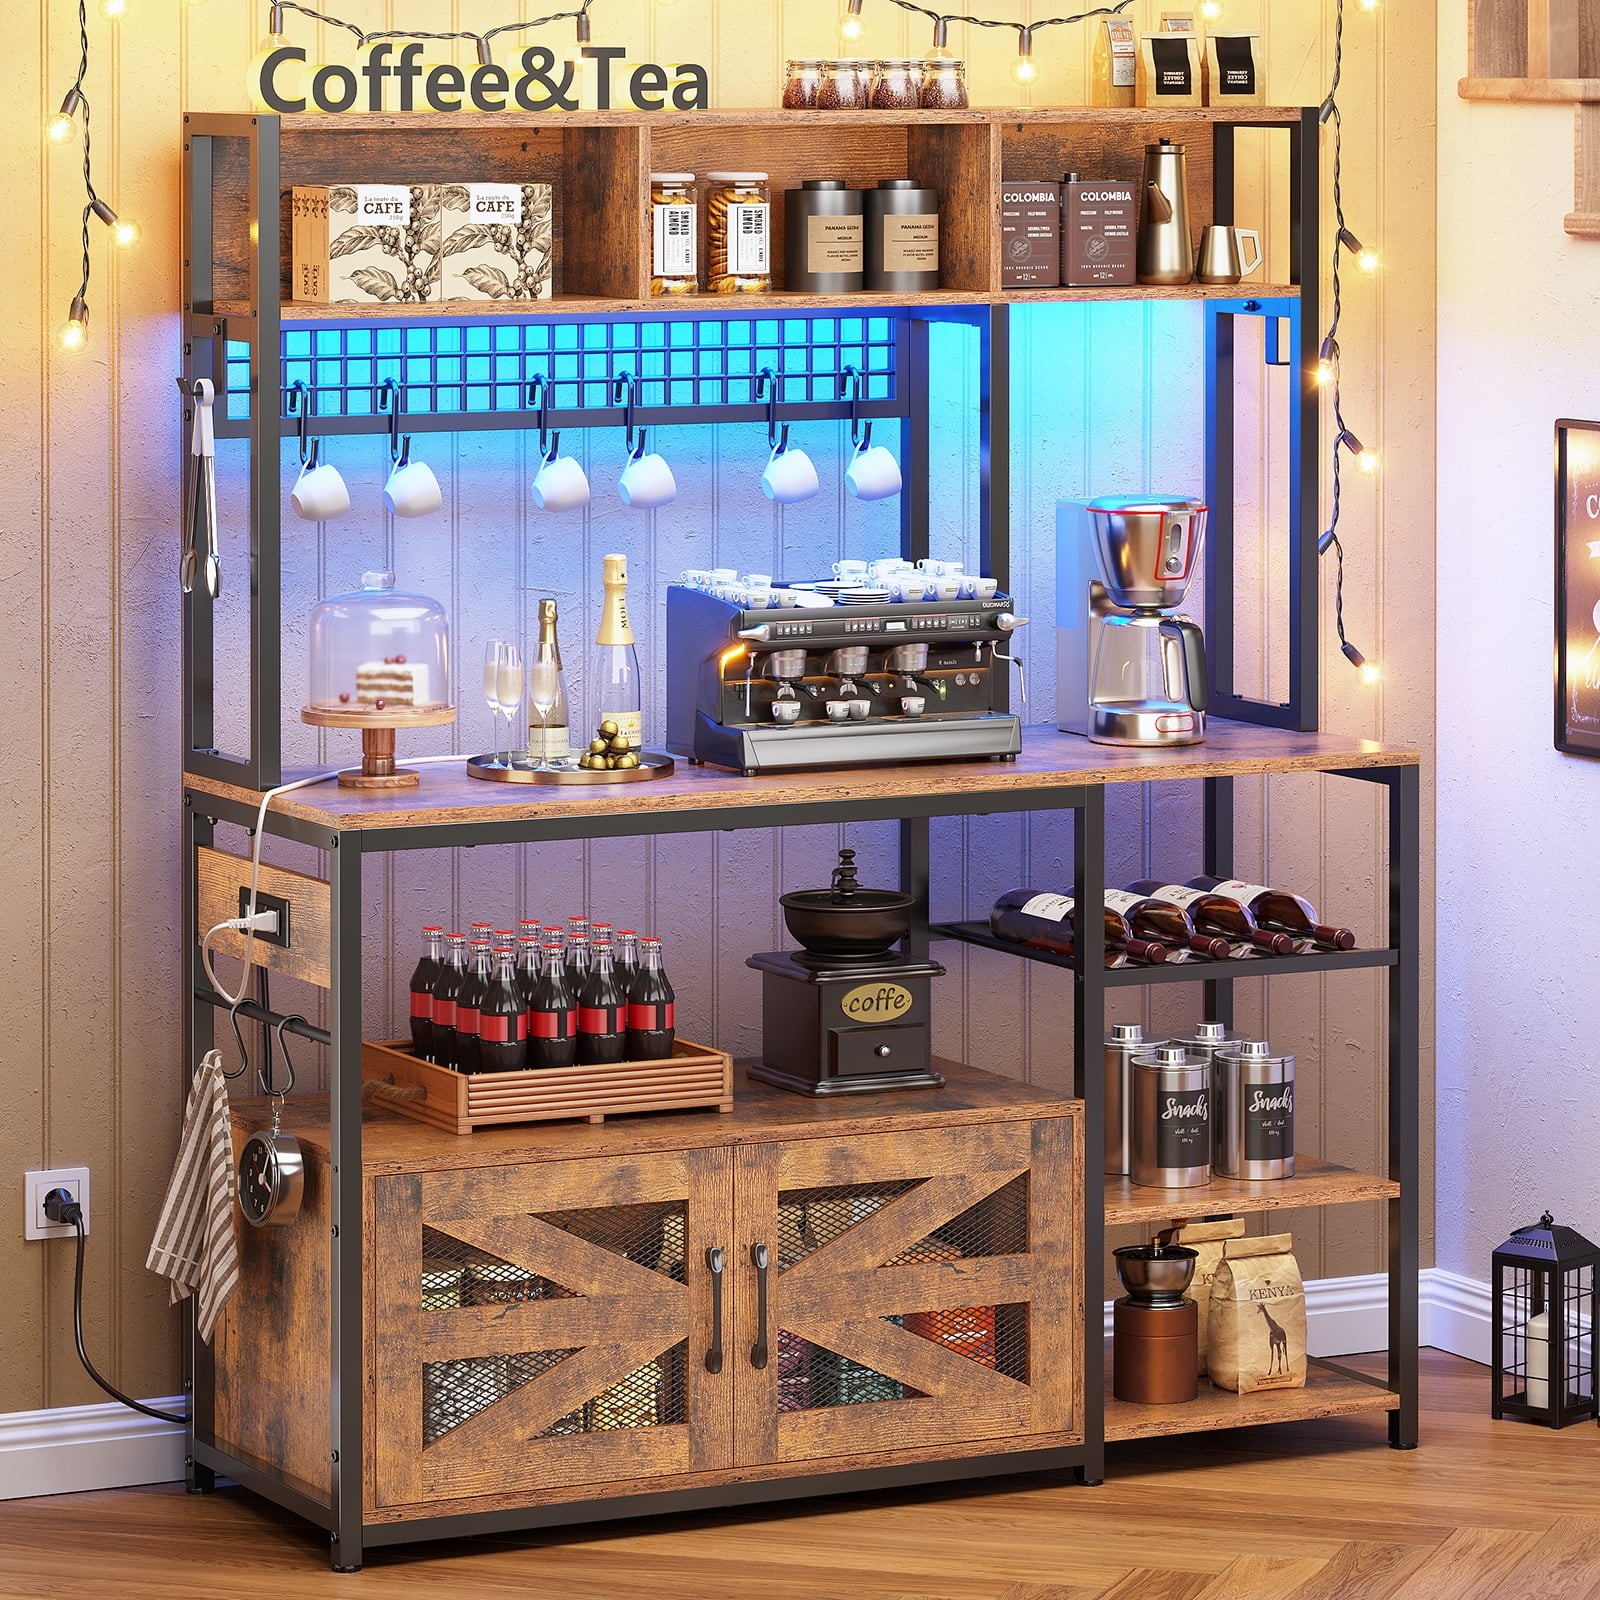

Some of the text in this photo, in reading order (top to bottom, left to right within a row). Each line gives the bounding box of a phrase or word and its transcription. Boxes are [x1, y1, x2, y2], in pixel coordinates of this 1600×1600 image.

[260, 43, 708, 113] Coffee&Tea
[1003, 192, 1056, 203] COLOMBIA
[1080, 191, 1132, 202] COLOMBIA
[363, 202, 403, 214] CAFE
[476, 201, 515, 213] CAFE
[849, 987, 906, 1013] coffe
[1161, 1094, 1208, 1120] Snacks
[1248, 1086, 1293, 1113] Snacks
[1249, 1285, 1294, 1300] KENYA
